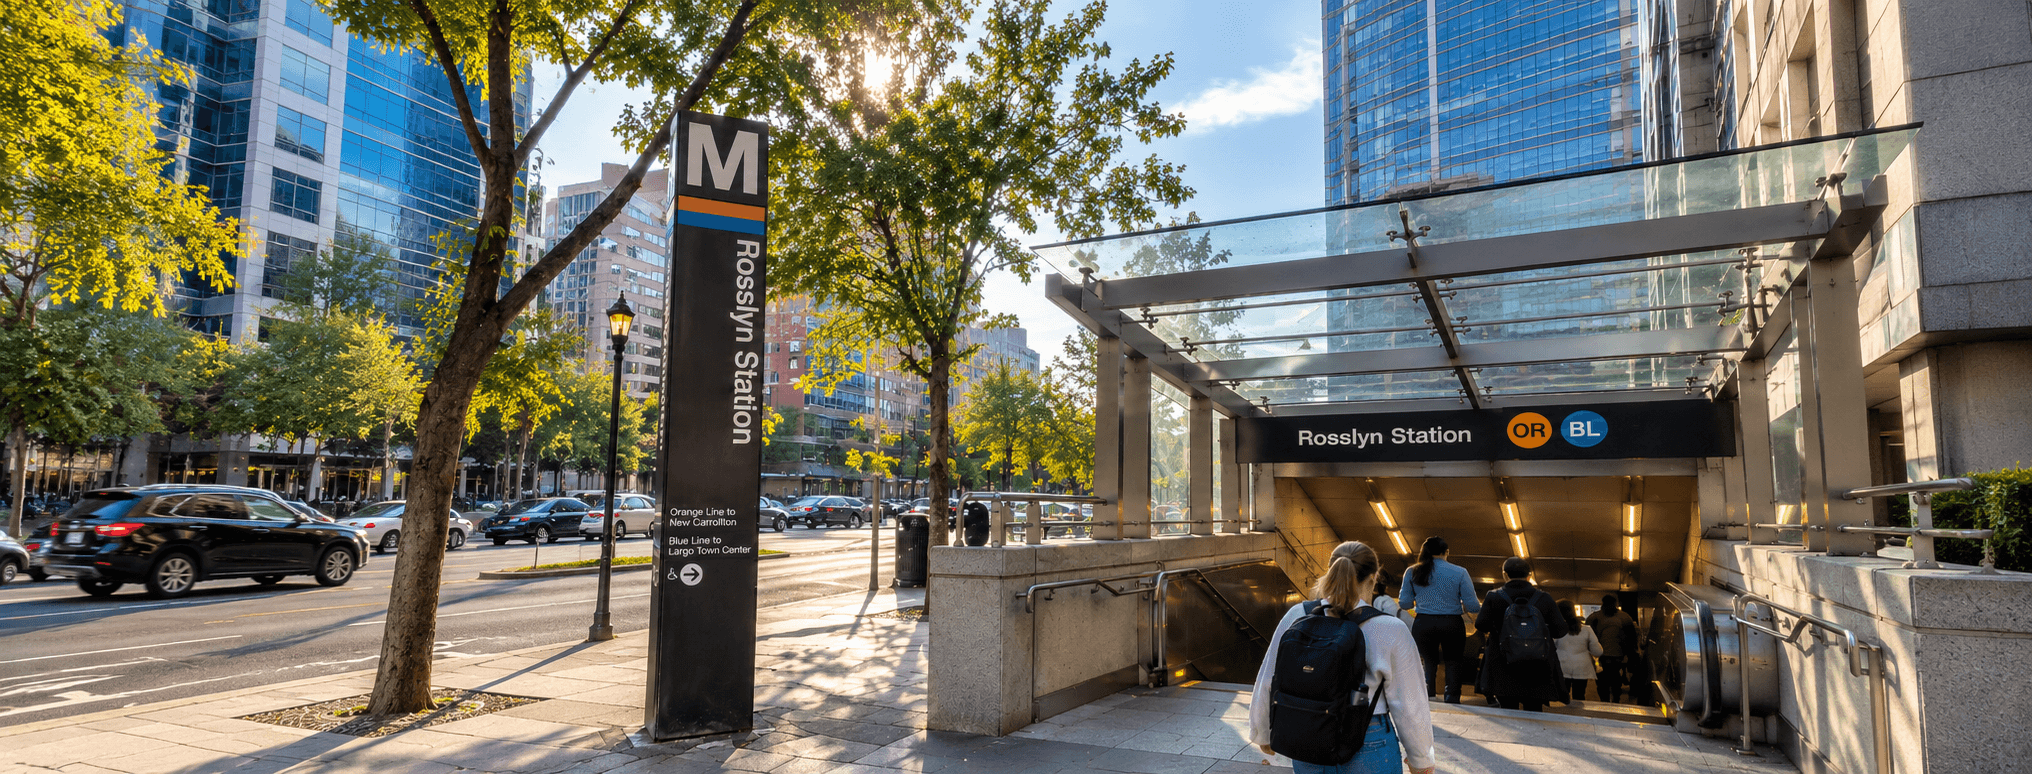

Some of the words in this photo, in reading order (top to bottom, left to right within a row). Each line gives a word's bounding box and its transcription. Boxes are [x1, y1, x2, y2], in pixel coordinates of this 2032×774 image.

[686, 122, 759, 195] M
[730, 239, 760, 343] Rosslyn
[733, 351, 759, 446] Station
[1512, 423, 1546, 438] OR
[1569, 421, 1601, 437] BL
[1298, 428, 1383, 449] Rosslyn
[1391, 426, 1472, 444] Station
[670, 508, 703, 517] Orange
[706, 507, 724, 516] Line
[726, 508, 735, 516] to
[669, 518, 690, 527] New
[668, 537, 689, 546] Blue
[691, 536, 710, 545] Line
[712, 536, 722, 544] to
[668, 547, 694, 557] Largo
[697, 547, 720, 555] Town
[722, 546, 751, 554] Center
